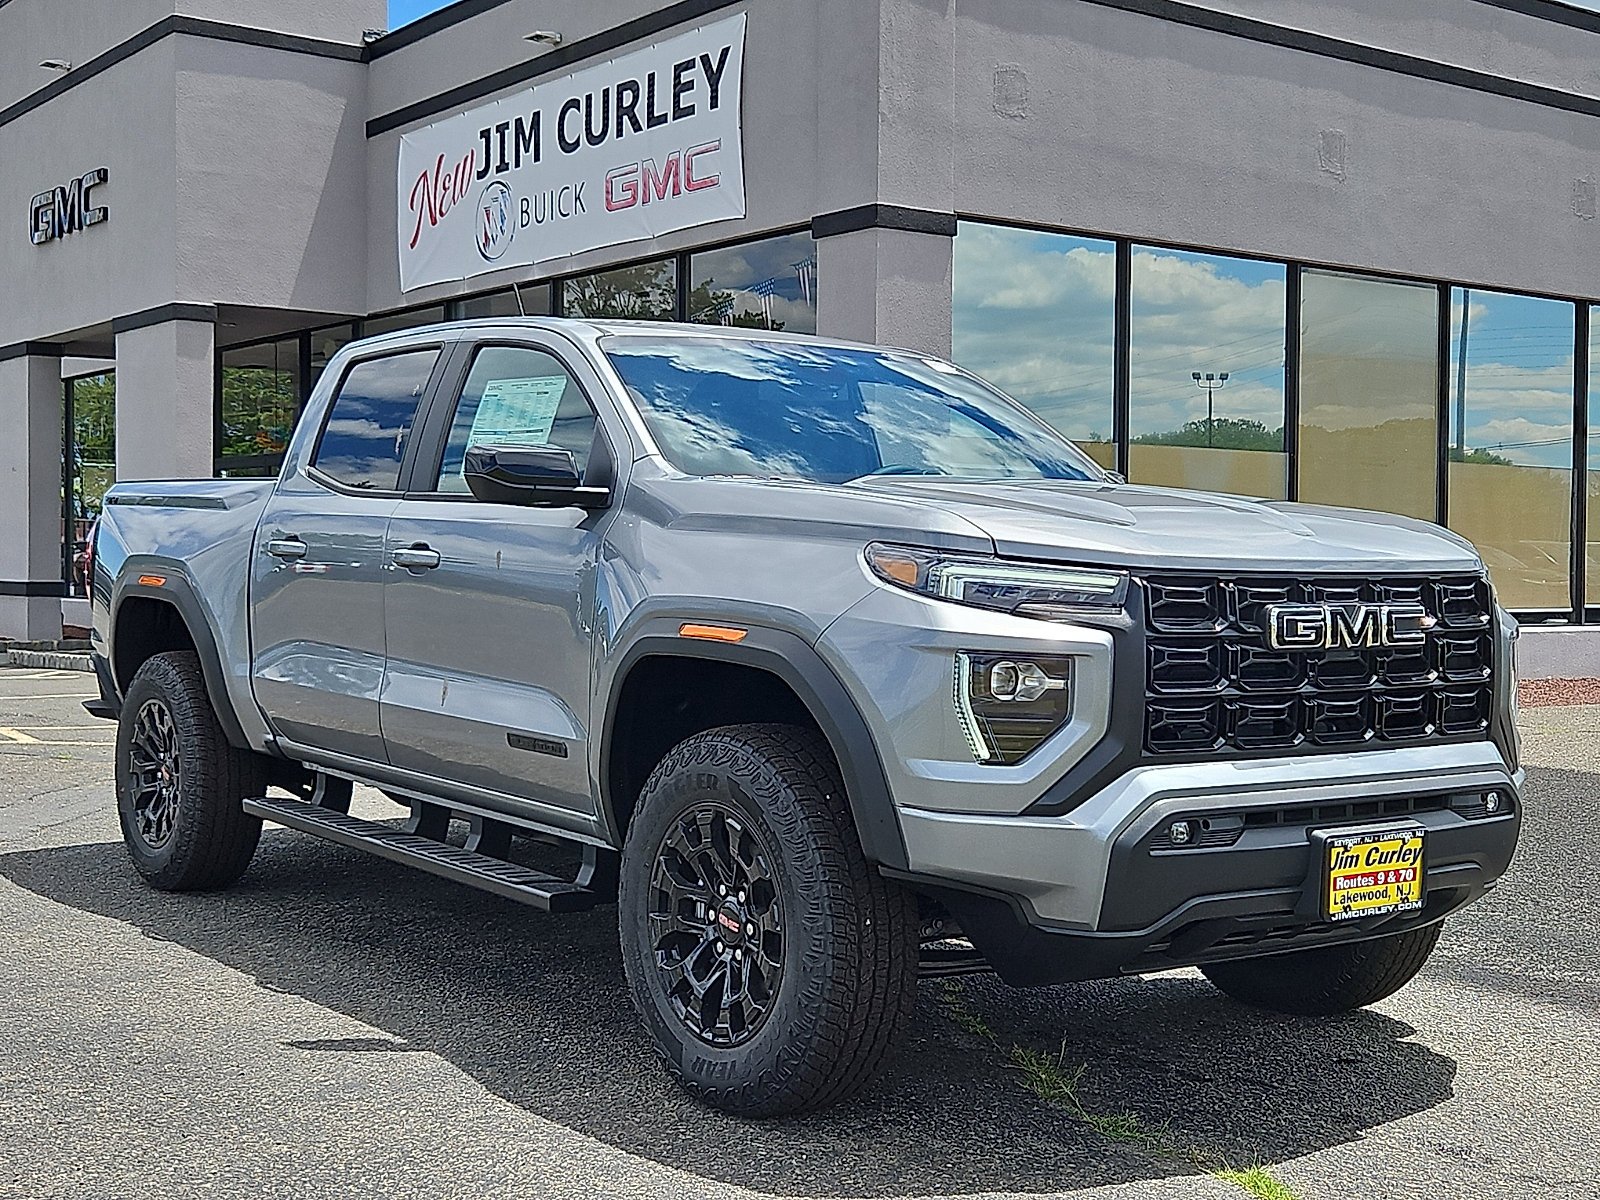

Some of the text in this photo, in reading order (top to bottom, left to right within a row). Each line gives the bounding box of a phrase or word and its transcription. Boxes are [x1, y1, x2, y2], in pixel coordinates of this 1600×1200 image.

[409, 46, 732, 250] New JIM CURLEY
[519, 138, 723, 228] BUICK GMC
[30, 167, 109, 246] GMC
[1267, 603, 1427, 651] GMC
[1331, 843, 1423, 871] Jim Curley
[1333, 882, 1415, 906] Lakewood, N.J.
[1336, 868, 1414, 890] Routes 9 & 70
[1331, 900, 1423, 921] JIMCURLEY.COM
